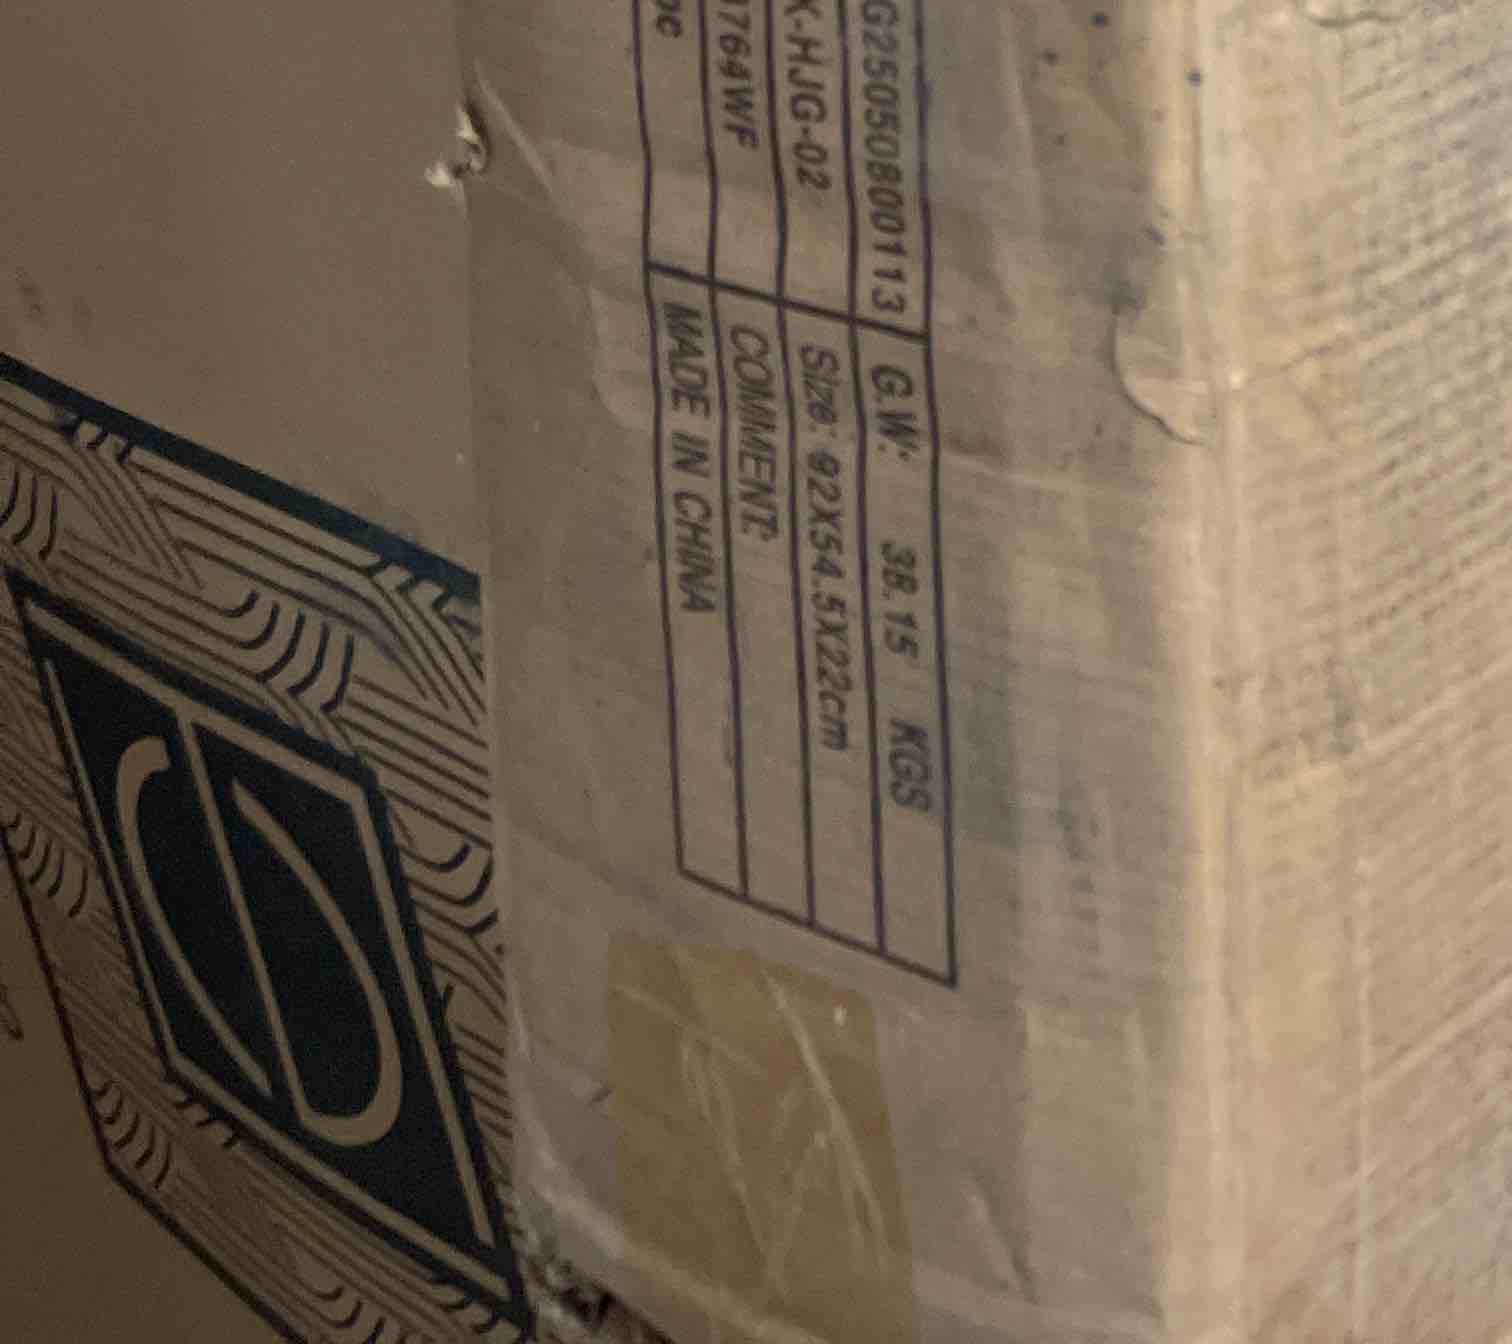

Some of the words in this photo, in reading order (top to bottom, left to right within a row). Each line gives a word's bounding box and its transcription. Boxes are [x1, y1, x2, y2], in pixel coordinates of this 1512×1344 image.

[664, 303, 711, 417] MADE
[799, 345, 842, 434] Size:
[672, 431, 712, 476] IN
[672, 491, 716, 613] CHINA
[886, 717, 932, 814] KGS
